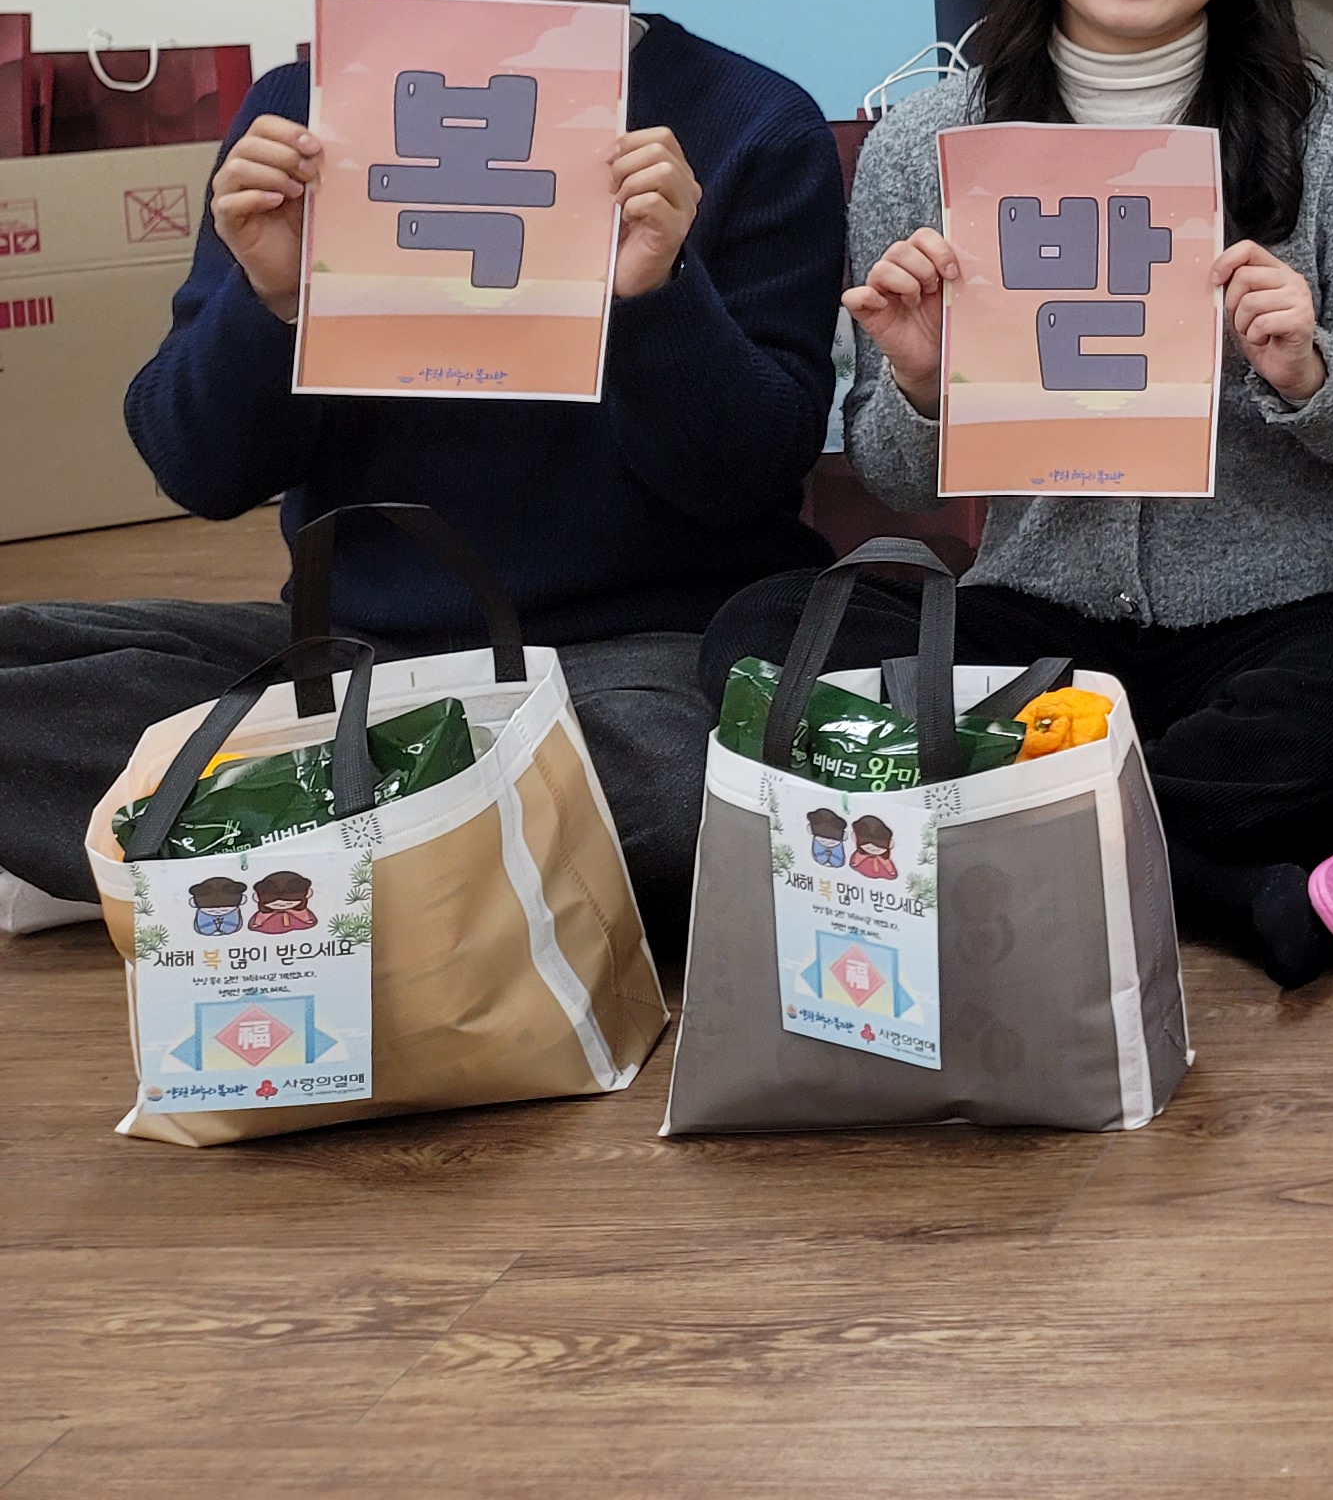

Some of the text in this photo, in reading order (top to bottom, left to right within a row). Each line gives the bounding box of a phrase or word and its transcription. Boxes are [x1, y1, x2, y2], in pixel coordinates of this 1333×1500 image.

[367, 70, 556, 289] 복
[998, 195, 1172, 391] 받
[813, 752, 857, 780] 비비고
[785, 871, 814, 892] 새해
[818, 879, 832, 902] 복
[837, 883, 864, 906] 많이
[870, 889, 926, 918] 받으세요
[153, 939, 355, 970] 새해 복 많이 받으세요
[238, 1020, 271, 1050] 福
[282, 1073, 365, 1092] 사랑의열매
